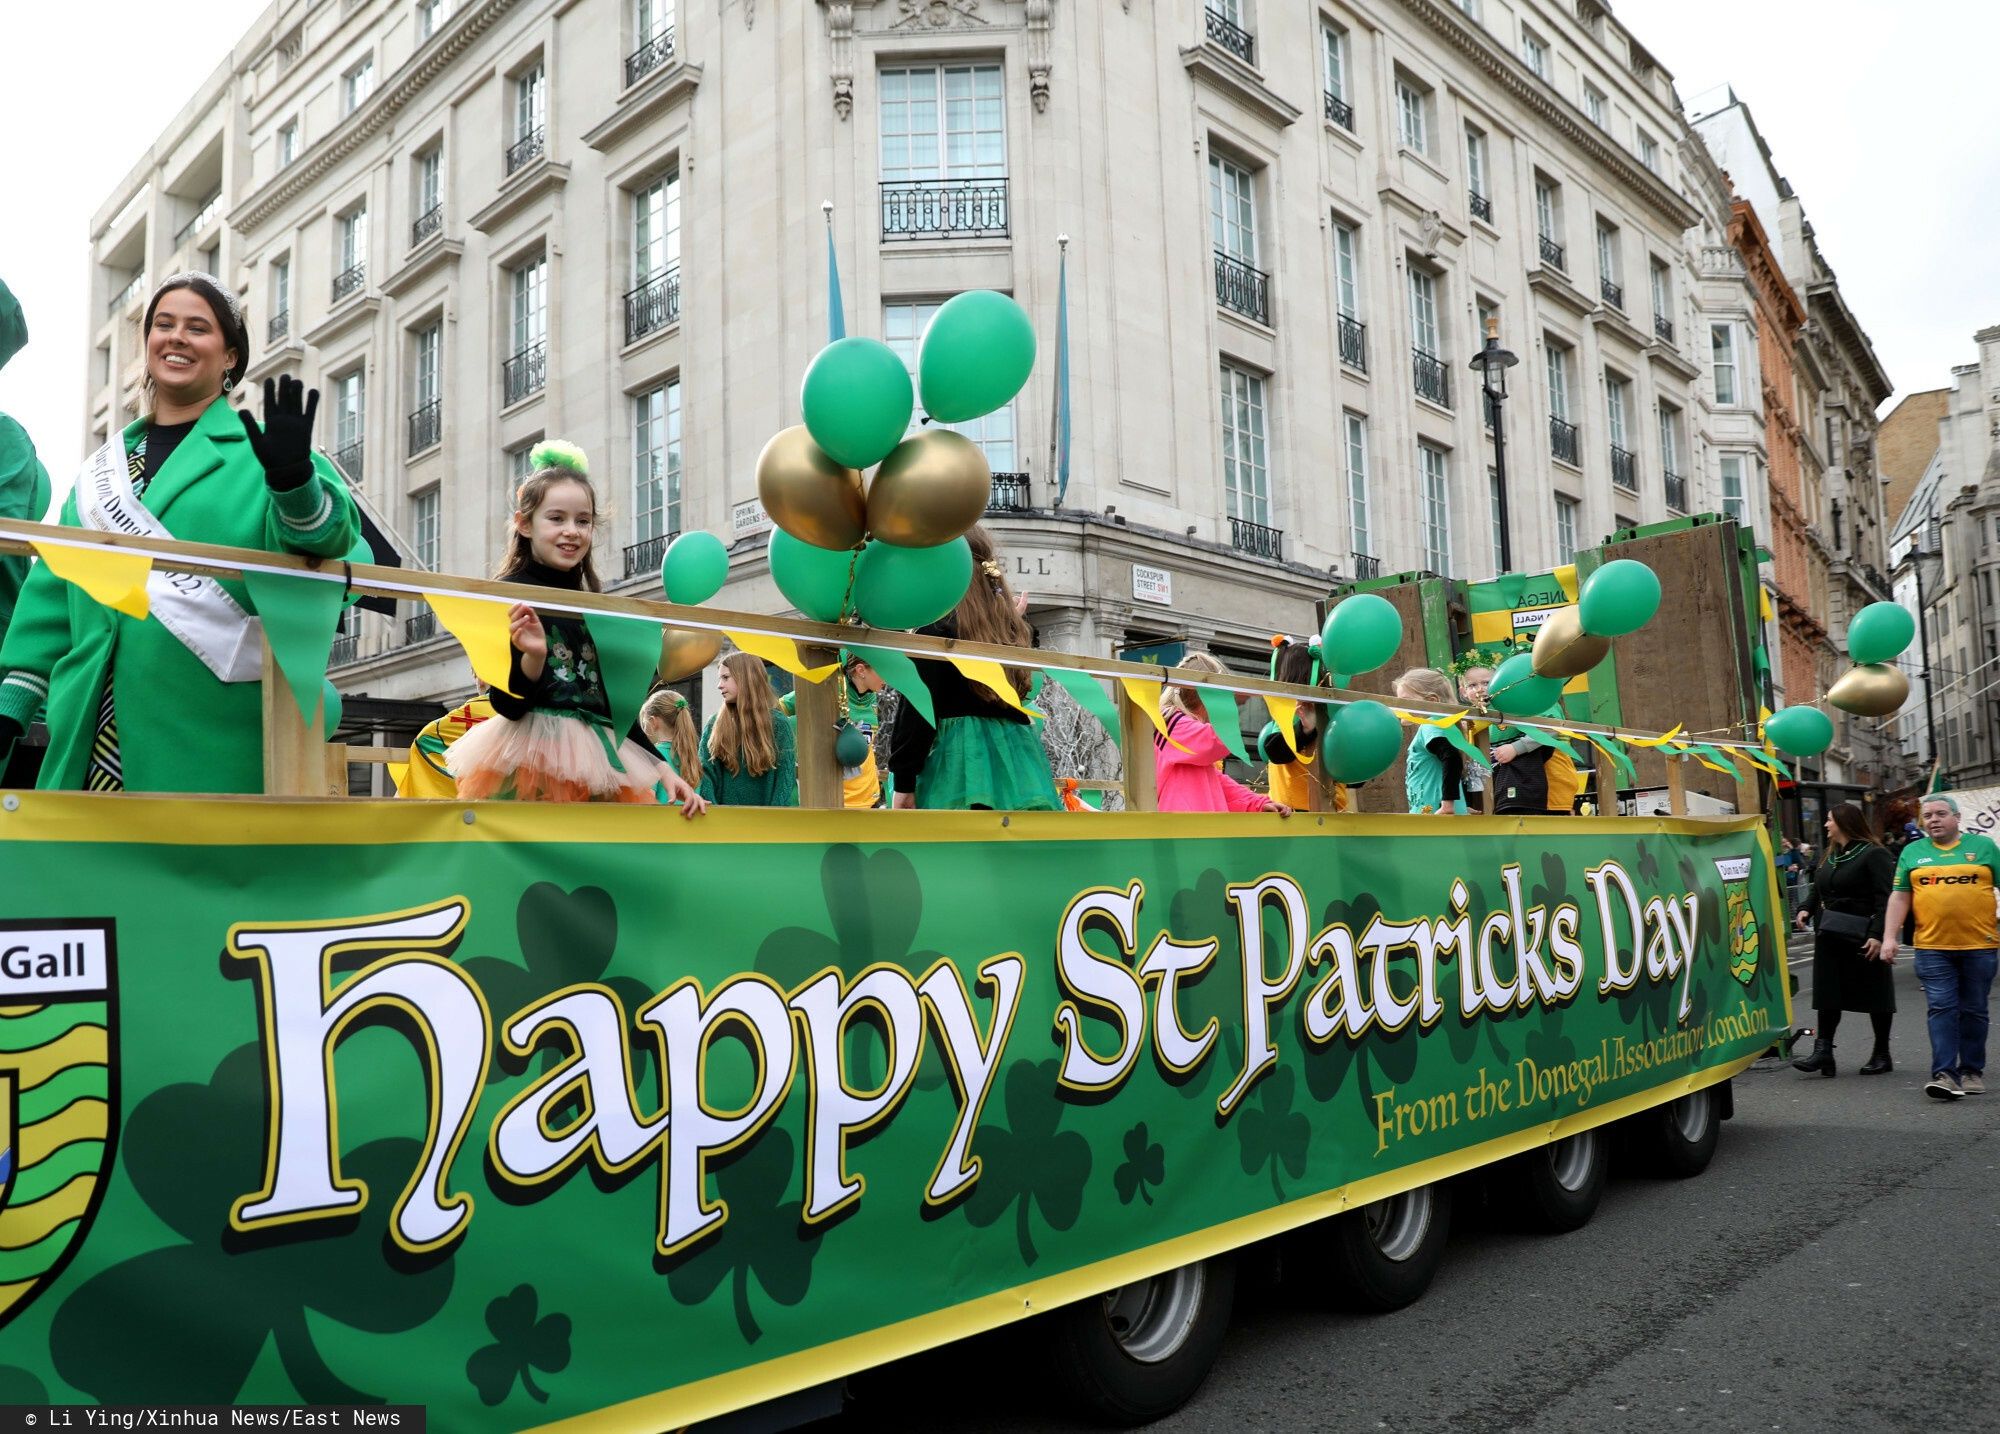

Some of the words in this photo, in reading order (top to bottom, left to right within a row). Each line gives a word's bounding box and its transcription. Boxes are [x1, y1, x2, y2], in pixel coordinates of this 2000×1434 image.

[998, 556, 1051, 576] ELL
[1136, 568, 1165, 583] COCKSPUR
[1136, 579, 1156, 591] STREET
[1157, 583, 1169, 593] SW1
[1919, 873, 1979, 886] circet
[1053, 877, 1220, 1092] St
[1216, 861, 1586, 1117] Patricks
[1584, 858, 1699, 1026] Day
[1372, 1085, 1460, 1159] From
[1465, 1066, 1512, 1120] the
[1514, 1038, 1610, 1109] Donegal
[1612, 1021, 1705, 1080] Association
[1706, 1000, 1770, 1049] London
